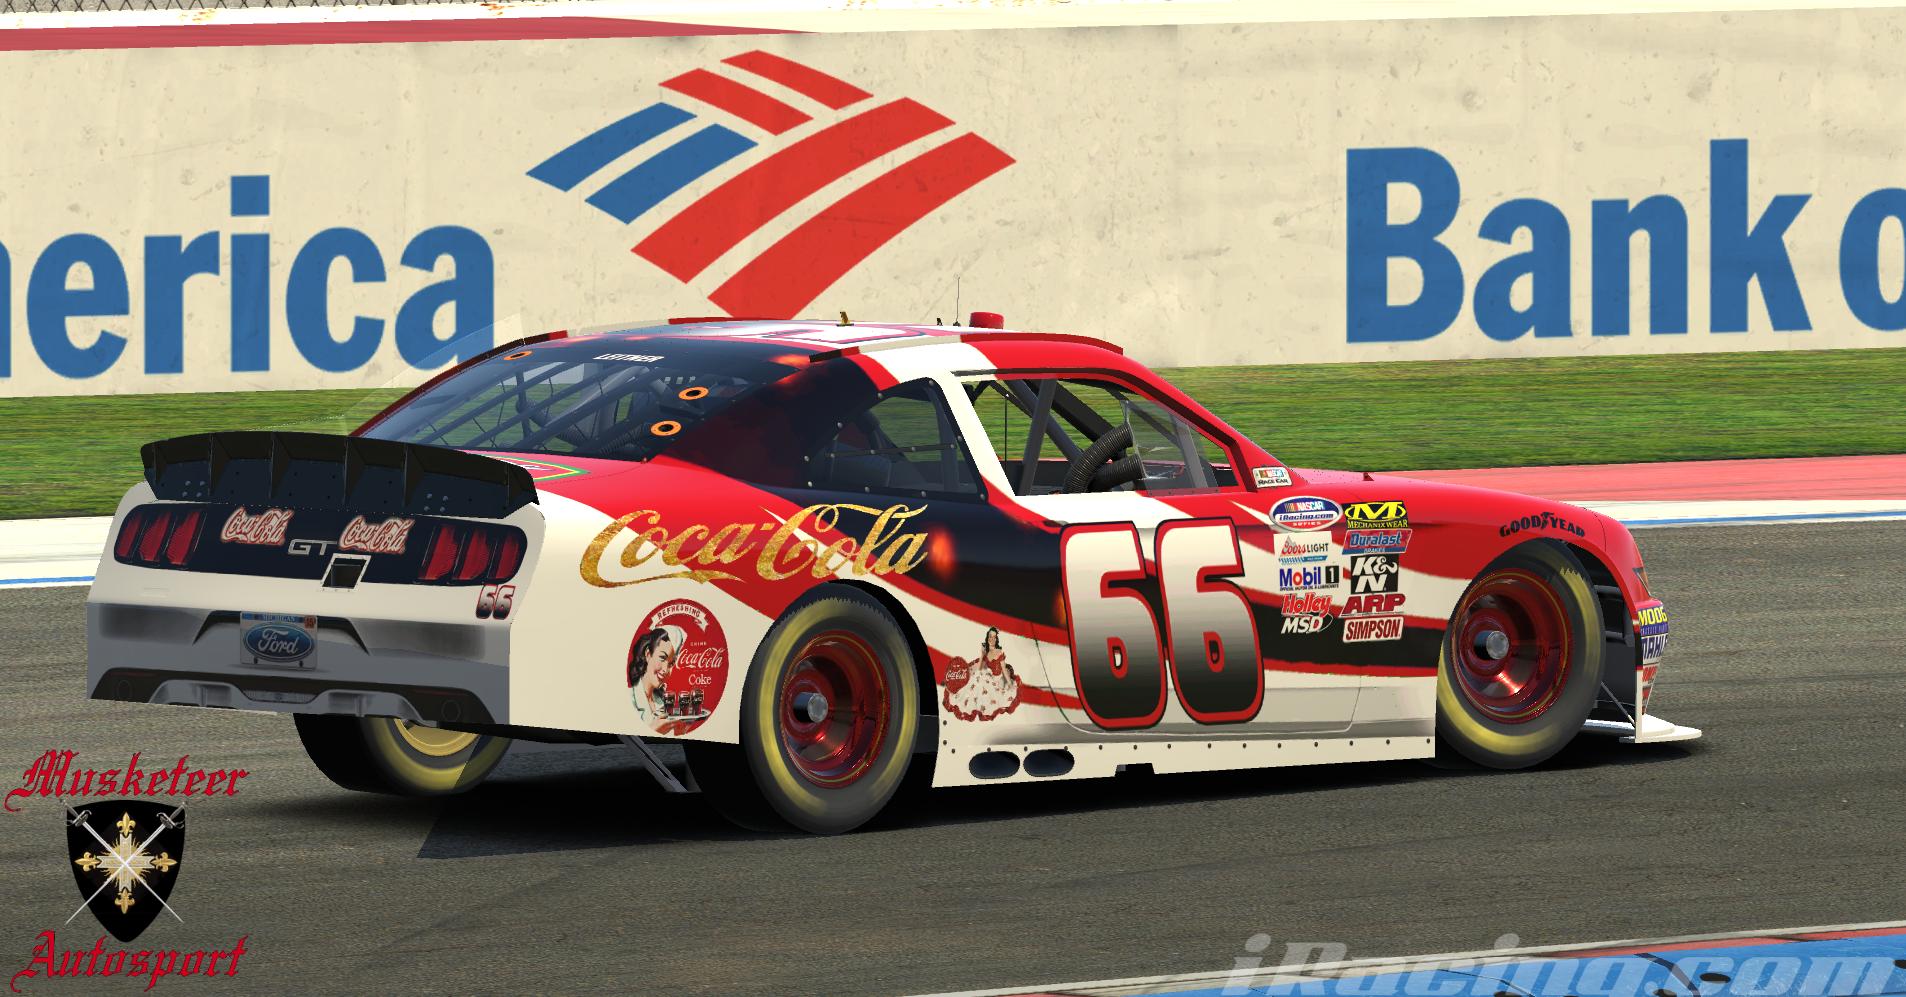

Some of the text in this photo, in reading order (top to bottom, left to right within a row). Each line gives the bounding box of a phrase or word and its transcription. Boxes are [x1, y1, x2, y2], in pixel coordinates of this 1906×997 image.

[1346, 138, 1813, 343] Bank
[0, 175, 494, 379] erica
[1297, 501, 1325, 512] NASCAR
[1347, 519, 1408, 529] MECHANIX WEAR
[1499, 511, 1585, 538] GOODYEAR
[288, 539, 337, 556] GT
[580, 503, 929, 589] Coca-Cola
[1281, 542, 1329, 555] Coors LIGHT
[1350, 532, 1402, 548] Duralast
[1279, 566, 1321, 587] Mobil
[475, 583, 516, 621] 66
[657, 604, 701, 620] REFRESHING
[1282, 592, 1333, 618] Holley
[1341, 593, 1406, 614] ARP
[1060, 516, 1265, 732] 66
[1281, 617, 1325, 635] MSD
[1345, 618, 1402, 641] SIMPSON
[257, 628, 300, 655] Ford
[688, 673, 712, 686] Coke
